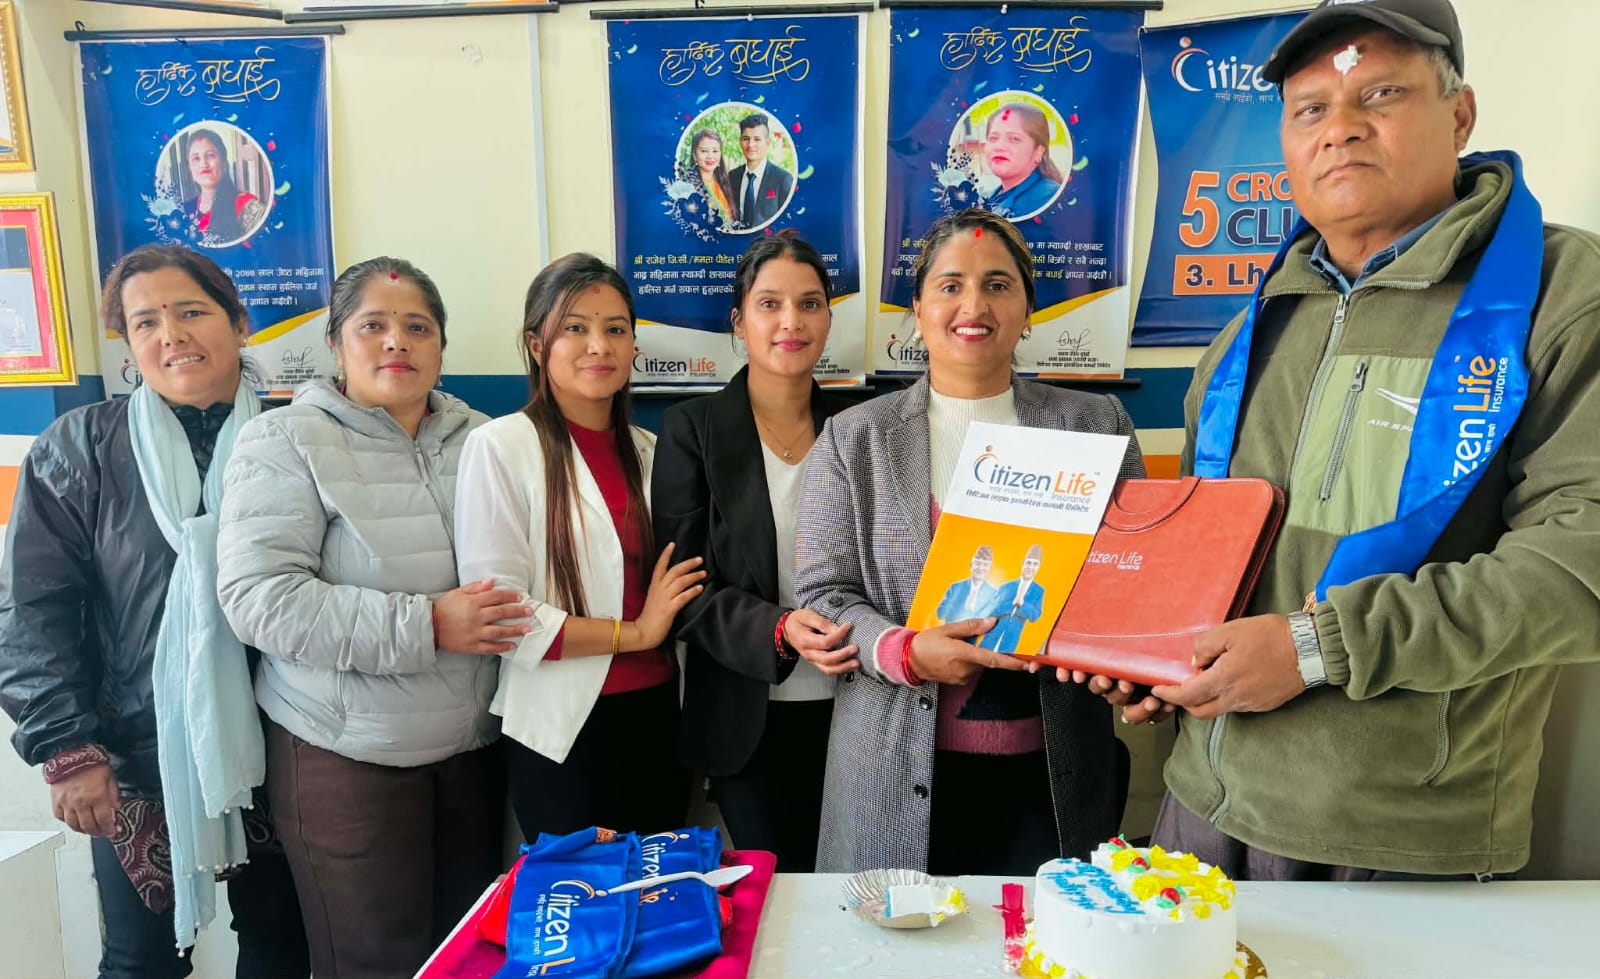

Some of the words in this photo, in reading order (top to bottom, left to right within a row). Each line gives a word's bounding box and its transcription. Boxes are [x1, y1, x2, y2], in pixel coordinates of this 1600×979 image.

[659, 41, 725, 86] हार्दिक
[724, 25, 809, 84] बधाई
[940, 26, 1007, 70] हार्दिक
[1007, 16, 1092, 72] बधाई
[1171, 48, 1274, 92] Citize
[135, 61, 197, 105] हार्दिक
[196, 46, 280, 102] बधाई
[1179, 170, 1219, 248] 5
[1226, 171, 1294, 203] CRO
[1185, 262, 1214, 287] 3.
[1226, 261, 1266, 287] Lh
[633, 350, 687, 373] Citizen
[689, 356, 716, 373] Life
[887, 339, 929, 361] Citize
[1453, 355, 1496, 412] Life
[1488, 356, 1509, 413] Insurance
[974, 452, 1052, 492] Citizen
[1054, 471, 1097, 497] Life
[1119, 550, 1144, 565] Life
[641, 832, 679, 880] Citize
[543, 879, 595, 957] Citizen
